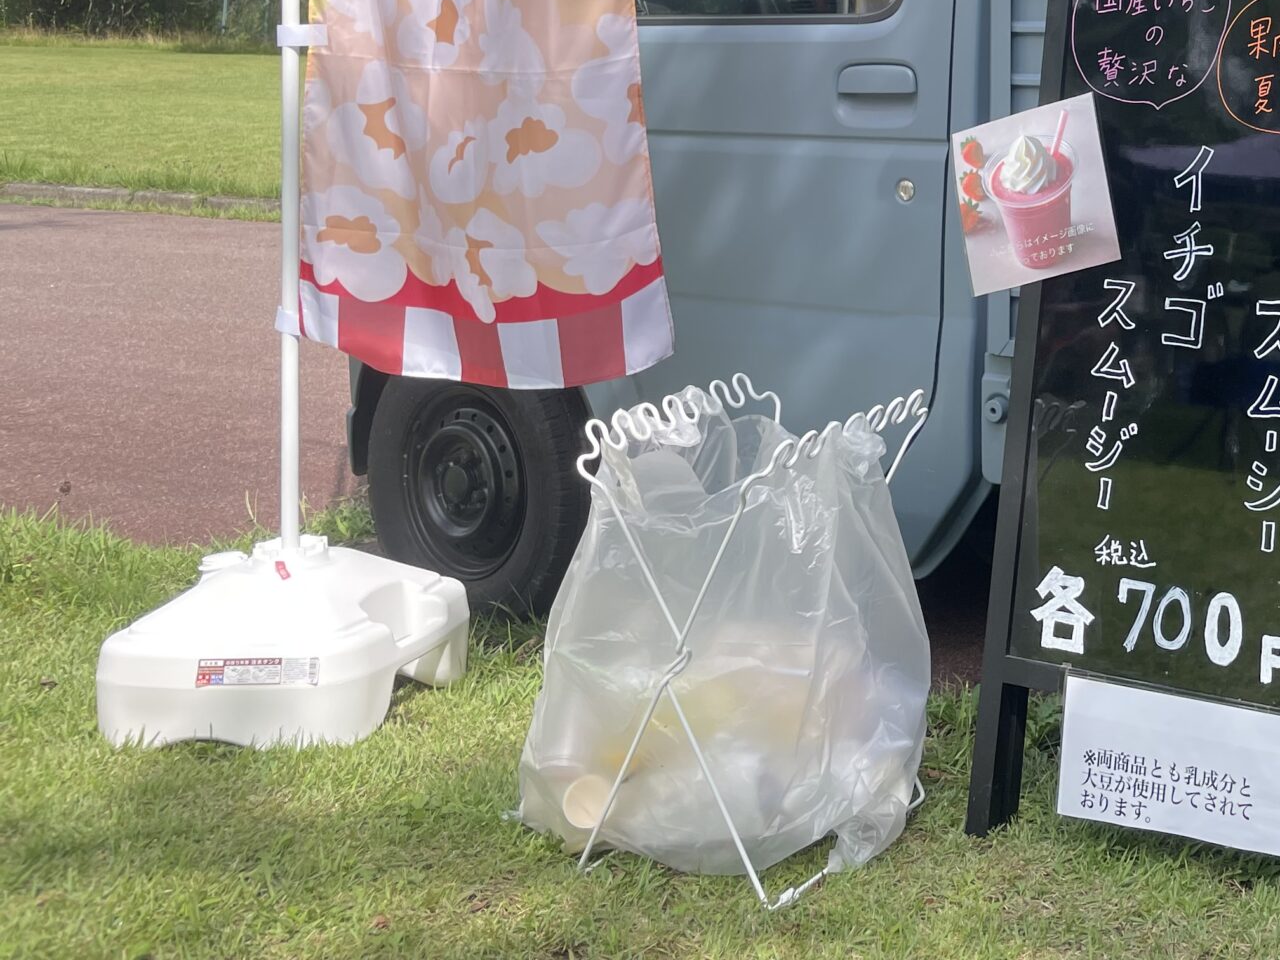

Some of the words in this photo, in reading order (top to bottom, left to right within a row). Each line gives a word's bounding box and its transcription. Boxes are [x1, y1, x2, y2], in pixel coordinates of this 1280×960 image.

[1145, 25, 1165, 47] の
[1097, 46, 1190, 87] 贅沢な
[1161, 145, 1224, 349] イチゴ
[1085, 279, 1138, 510] スムージー
[1094, 534, 1157, 568] 税込
[1080, 790, 1151, 824] おります。
[1081, 767, 1254, 821] 大豆が使用してされて
